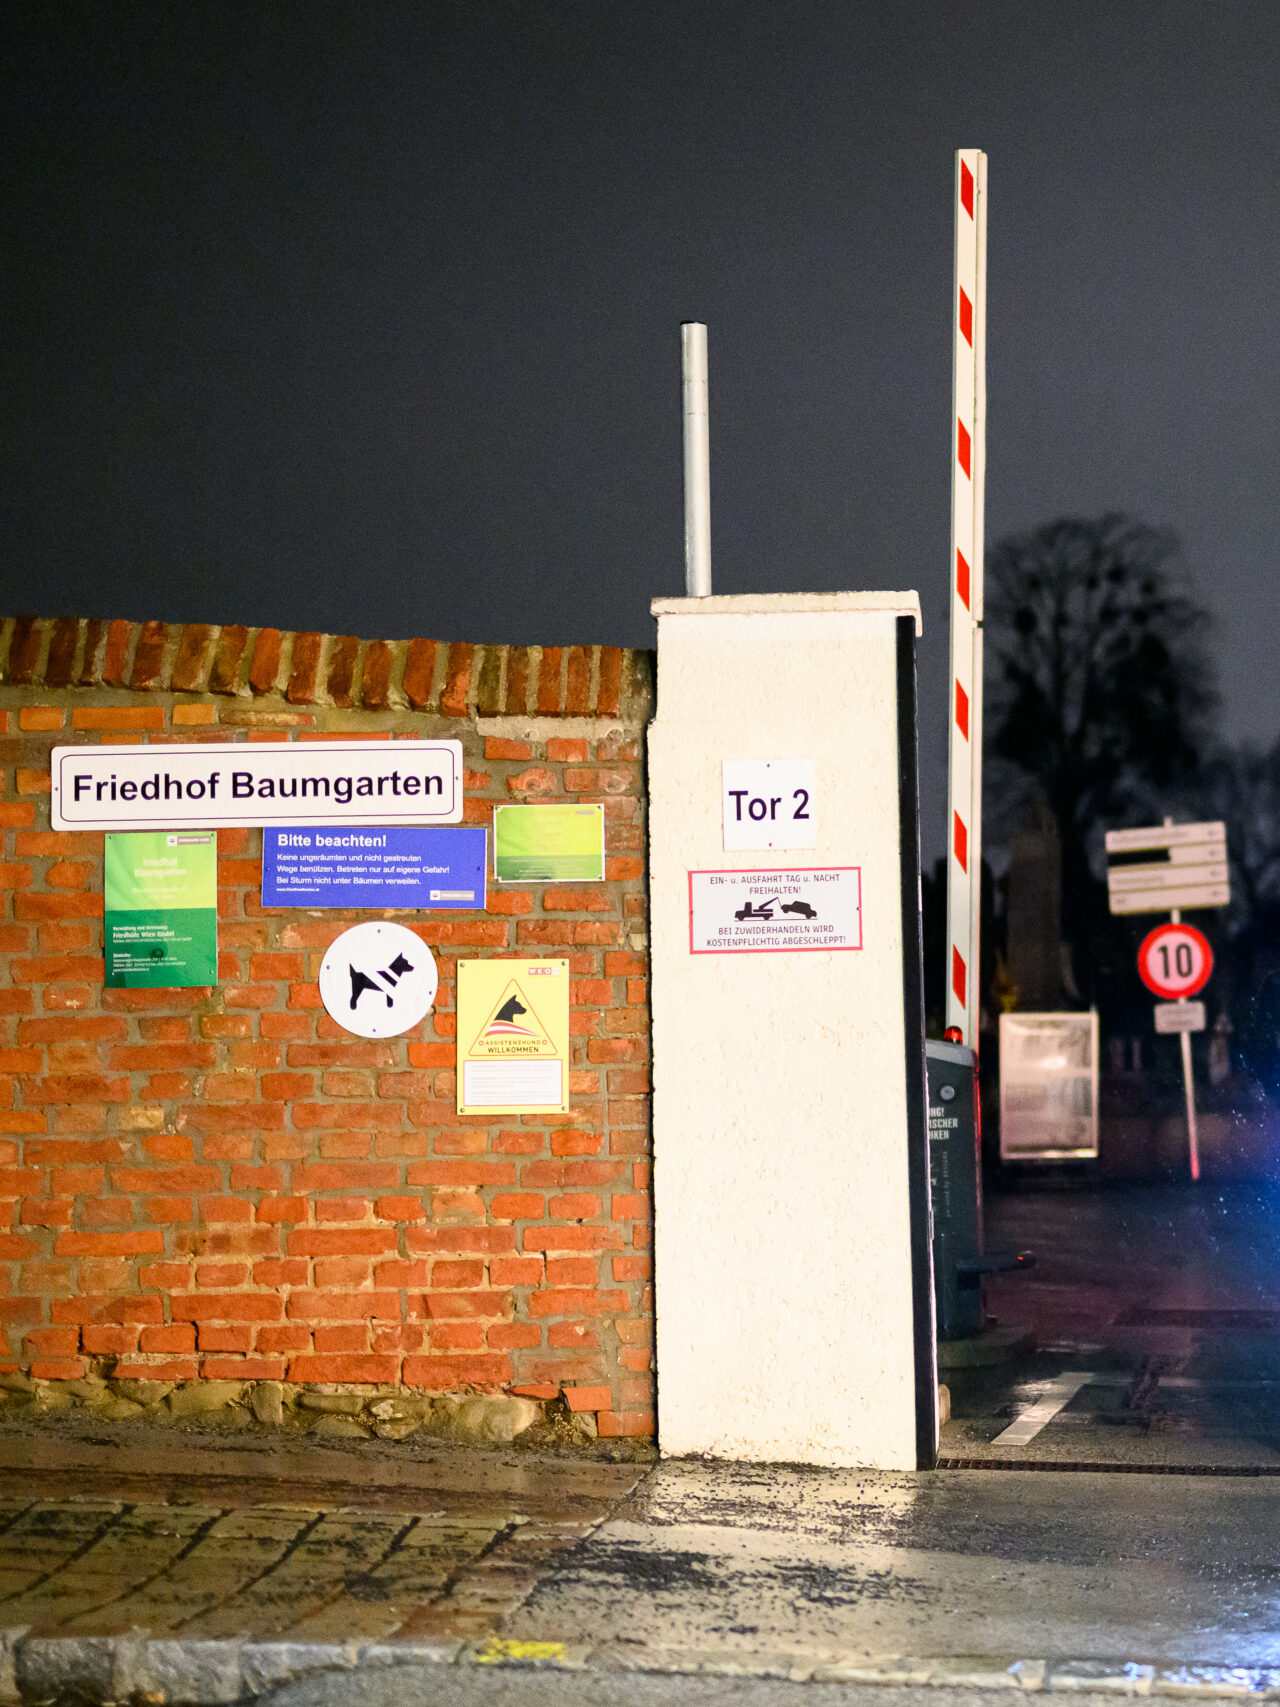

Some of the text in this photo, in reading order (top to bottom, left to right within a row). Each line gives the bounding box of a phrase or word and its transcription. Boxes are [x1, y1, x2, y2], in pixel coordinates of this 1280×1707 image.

[73, 770, 443, 804] Friedhof Baumgarten
[728, 788, 810, 821] Tor 2
[277, 833, 387, 847] Bitte beachten!
[276, 853, 298, 861] Keine
[299, 853, 347, 863] ungeräumten
[364, 854, 382, 862] nicht
[383, 854, 422, 863] gestreuten
[276, 865, 298, 874] Wege
[299, 865, 335, 873] benützen.
[336, 865, 368, 873] Betreten
[396, 866, 421, 875] eigene
[422, 866, 450, 874] Gefahr!
[276, 876, 289, 884] Bei
[290, 876, 313, 884] Sturm
[352, 877, 384, 885] Bäumen
[384, 877, 422, 885] verweilen.
[709, 876, 728, 885] EIN-
[741, 875, 783, 884] AUSFAHRT
[786, 874, 801, 883] TAG
[803, 875, 811, 883] u.
[813, 873, 840, 882] NACHT
[749, 886, 802, 895] FREIHALTEN!
[718, 924, 834, 936] BEI ZUWIDERHANDELN WIRD
[706, 935, 847, 947] KOSTENPFLICHTIG ABGESCHLEPPT!
[1157, 942, 1193, 980] 10
[488, 1046, 539, 1054] WILLKOMMEN
